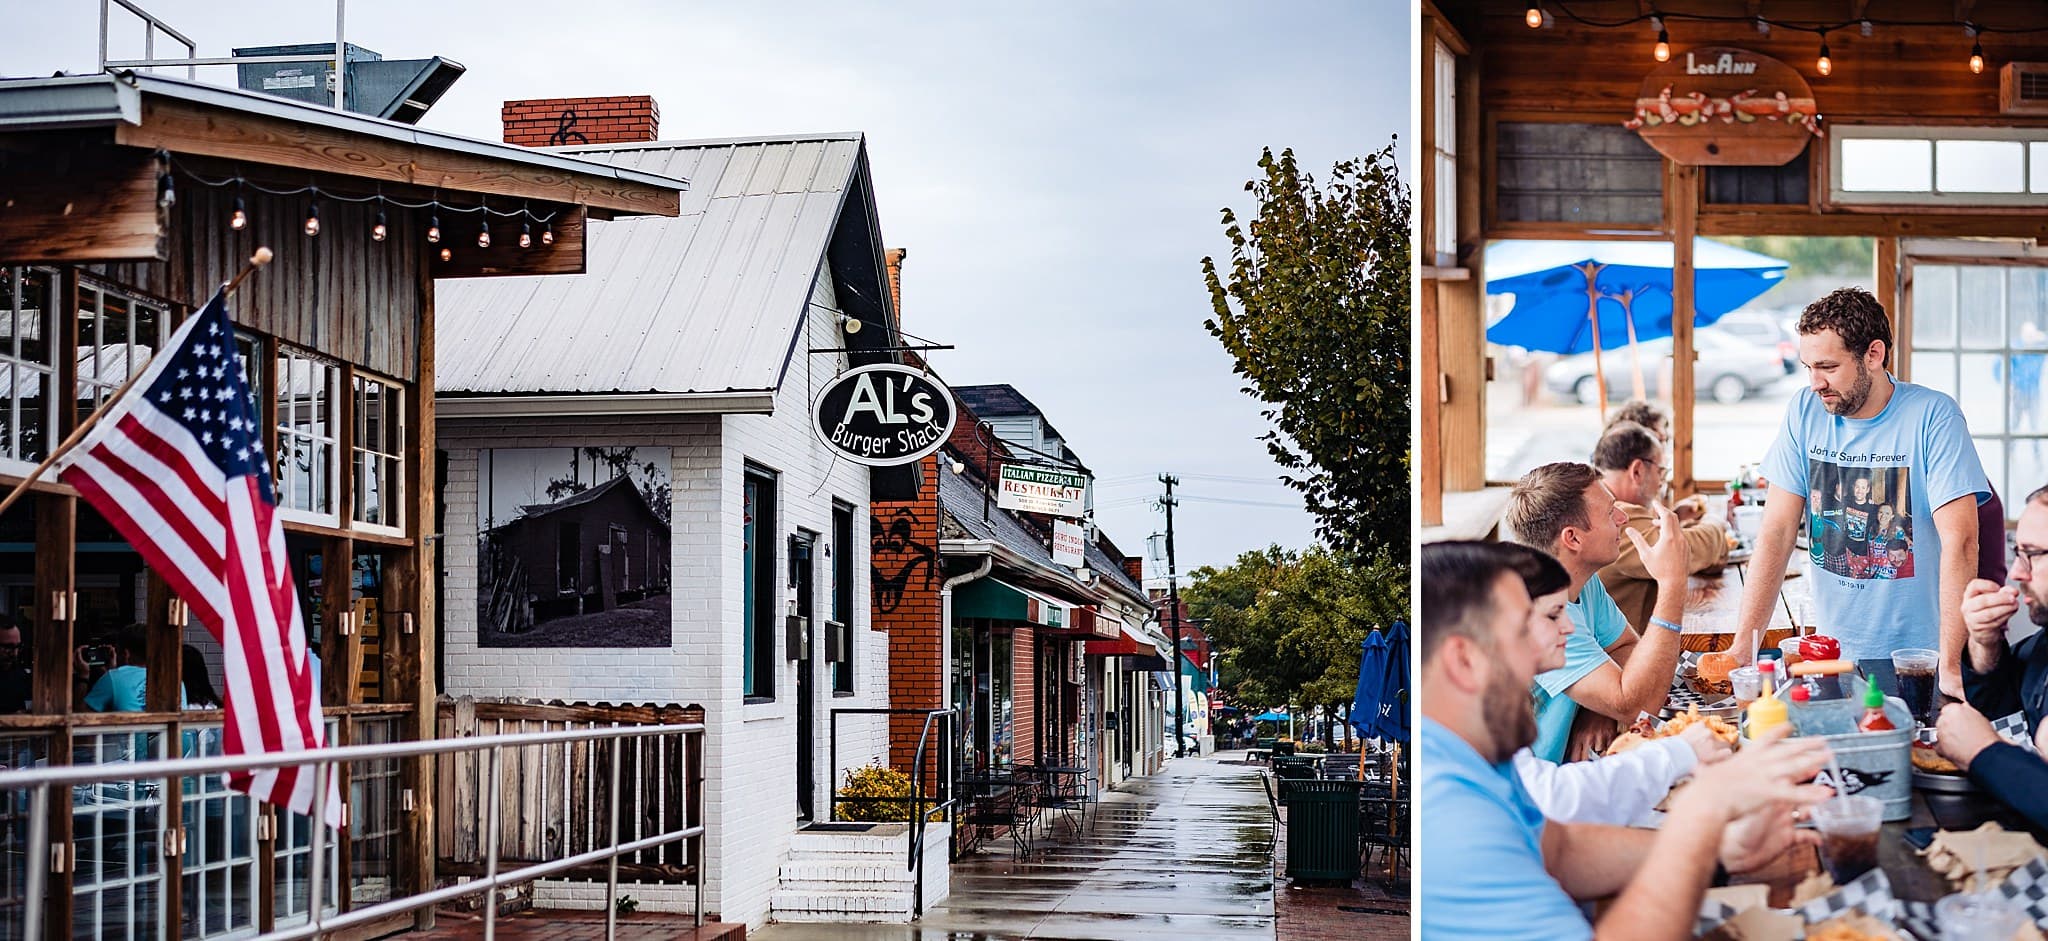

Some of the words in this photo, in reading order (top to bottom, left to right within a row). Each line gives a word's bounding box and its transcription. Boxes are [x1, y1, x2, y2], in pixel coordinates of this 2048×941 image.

[843, 373, 934, 425] AL's
[831, 423, 891, 457] Burger
[897, 419, 945, 453] Shack
[1810, 445, 1828, 457] Jon
[1838, 452, 1867, 462] Sarah
[1870, 453, 1906, 463] Forever
[1003, 468, 1034, 481] ITALIAN
[1074, 478, 1084, 487] III
[1004, 481, 1081, 500] RESTAURANT
[1054, 542, 1084, 556] RESTAURANT
